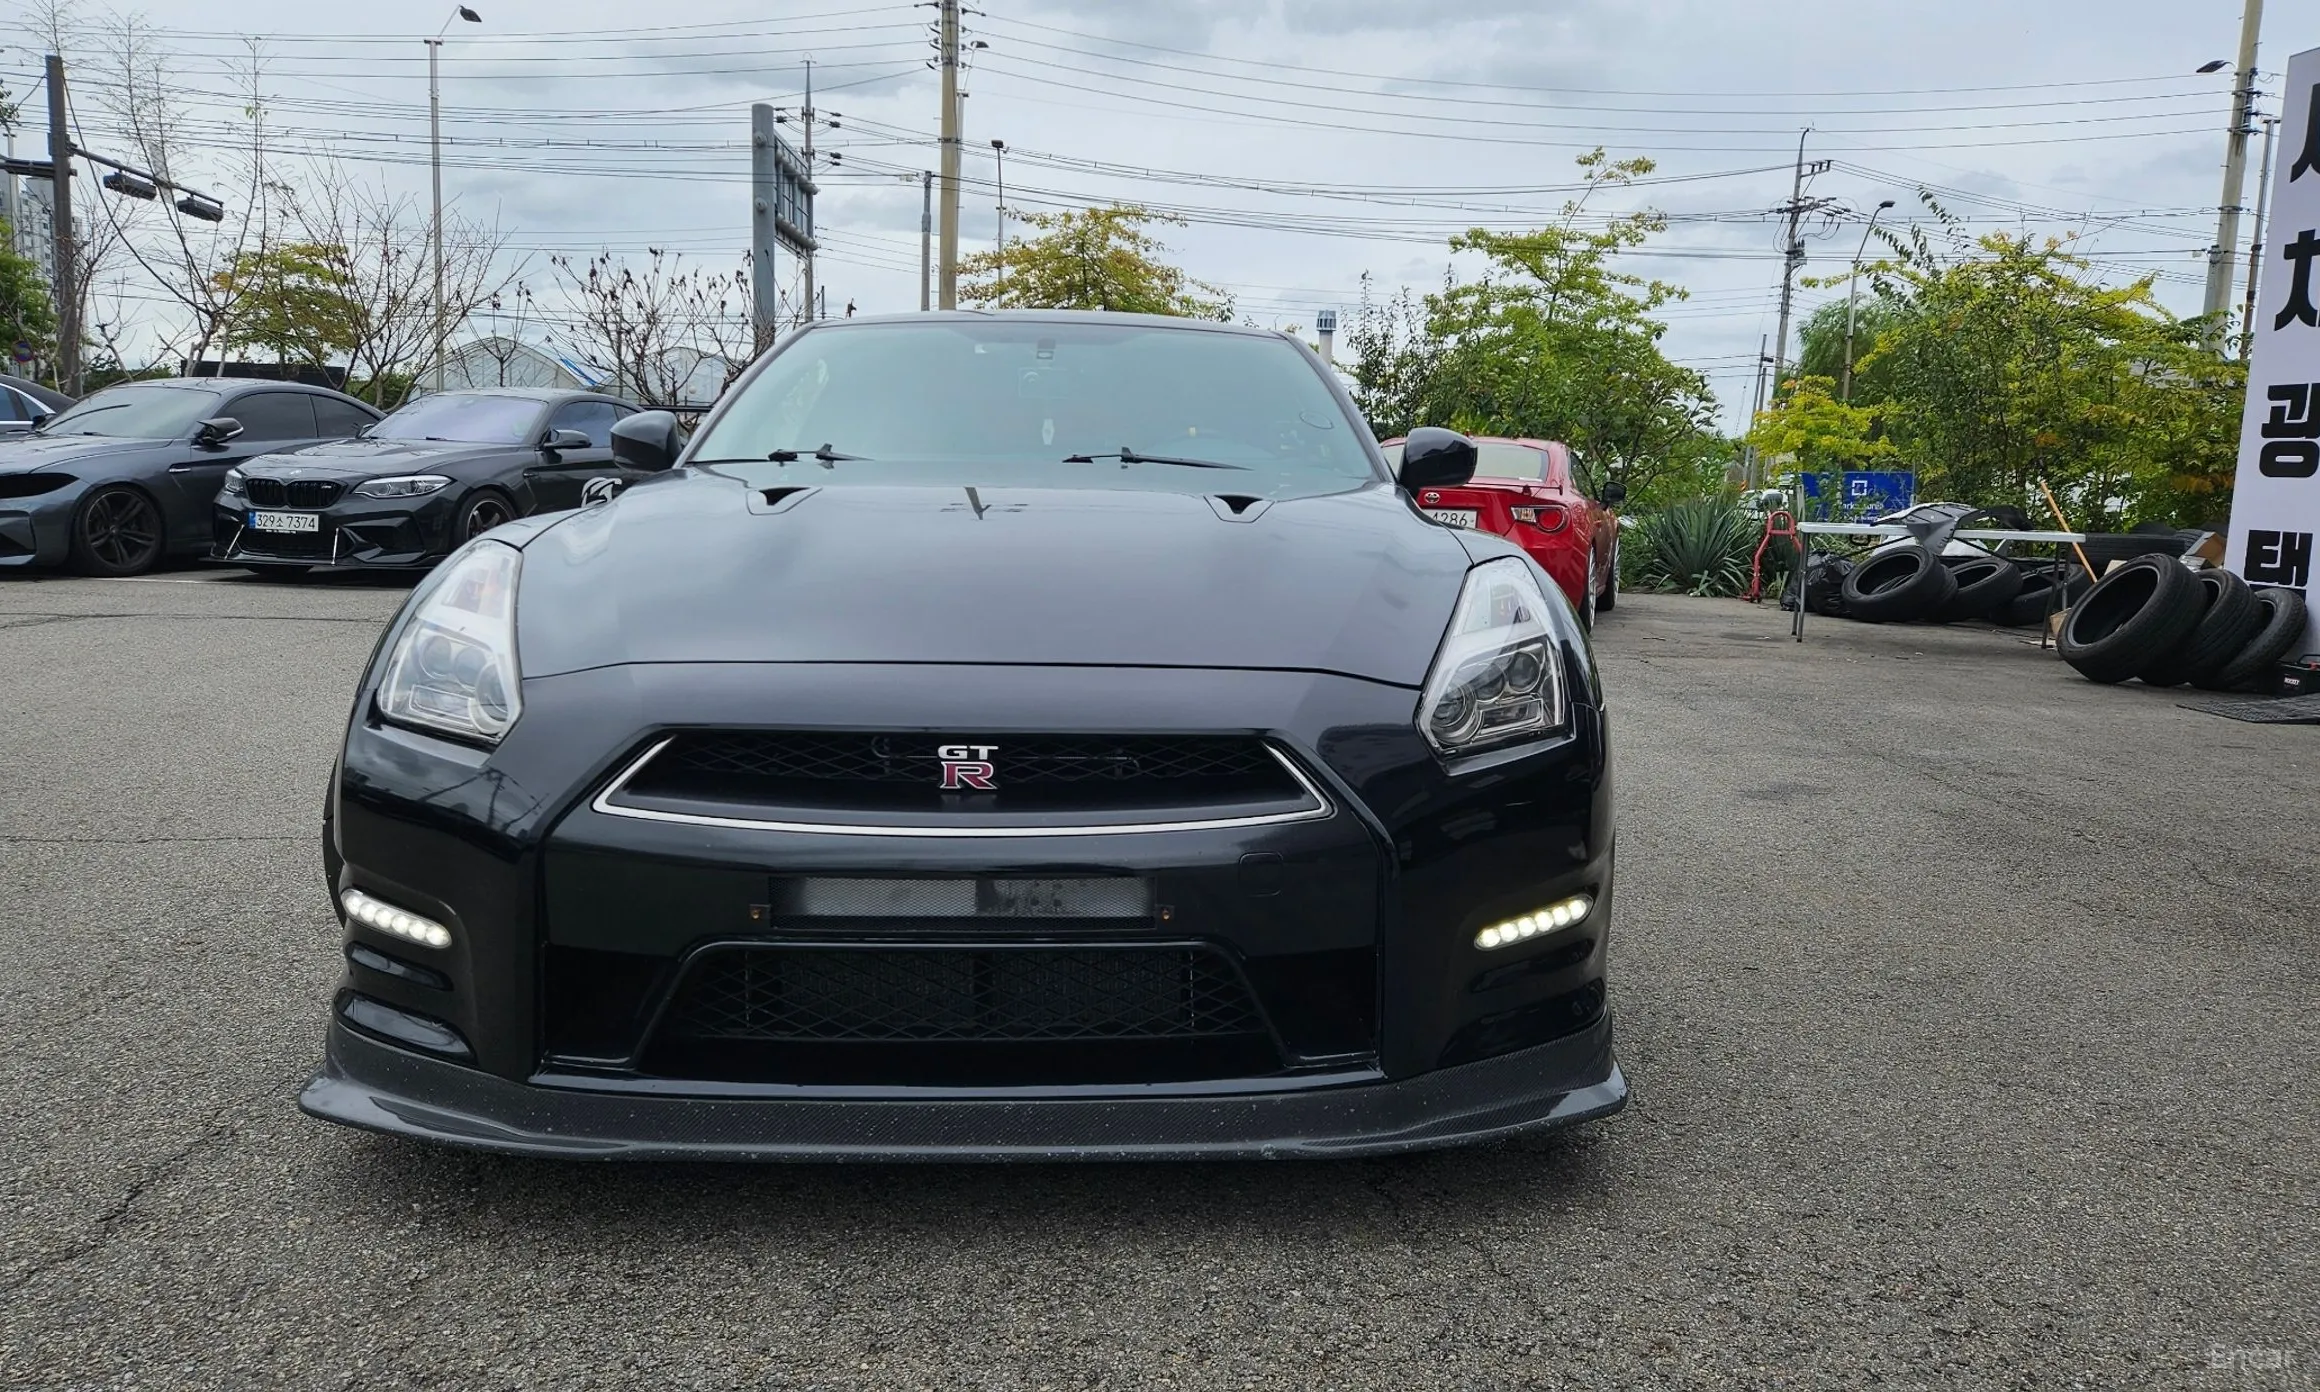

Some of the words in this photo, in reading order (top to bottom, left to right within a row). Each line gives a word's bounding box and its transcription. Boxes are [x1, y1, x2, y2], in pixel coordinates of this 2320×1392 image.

[286, 515, 316, 529] 7374
[937, 744, 999, 760] GT
[940, 761, 998, 789] R
